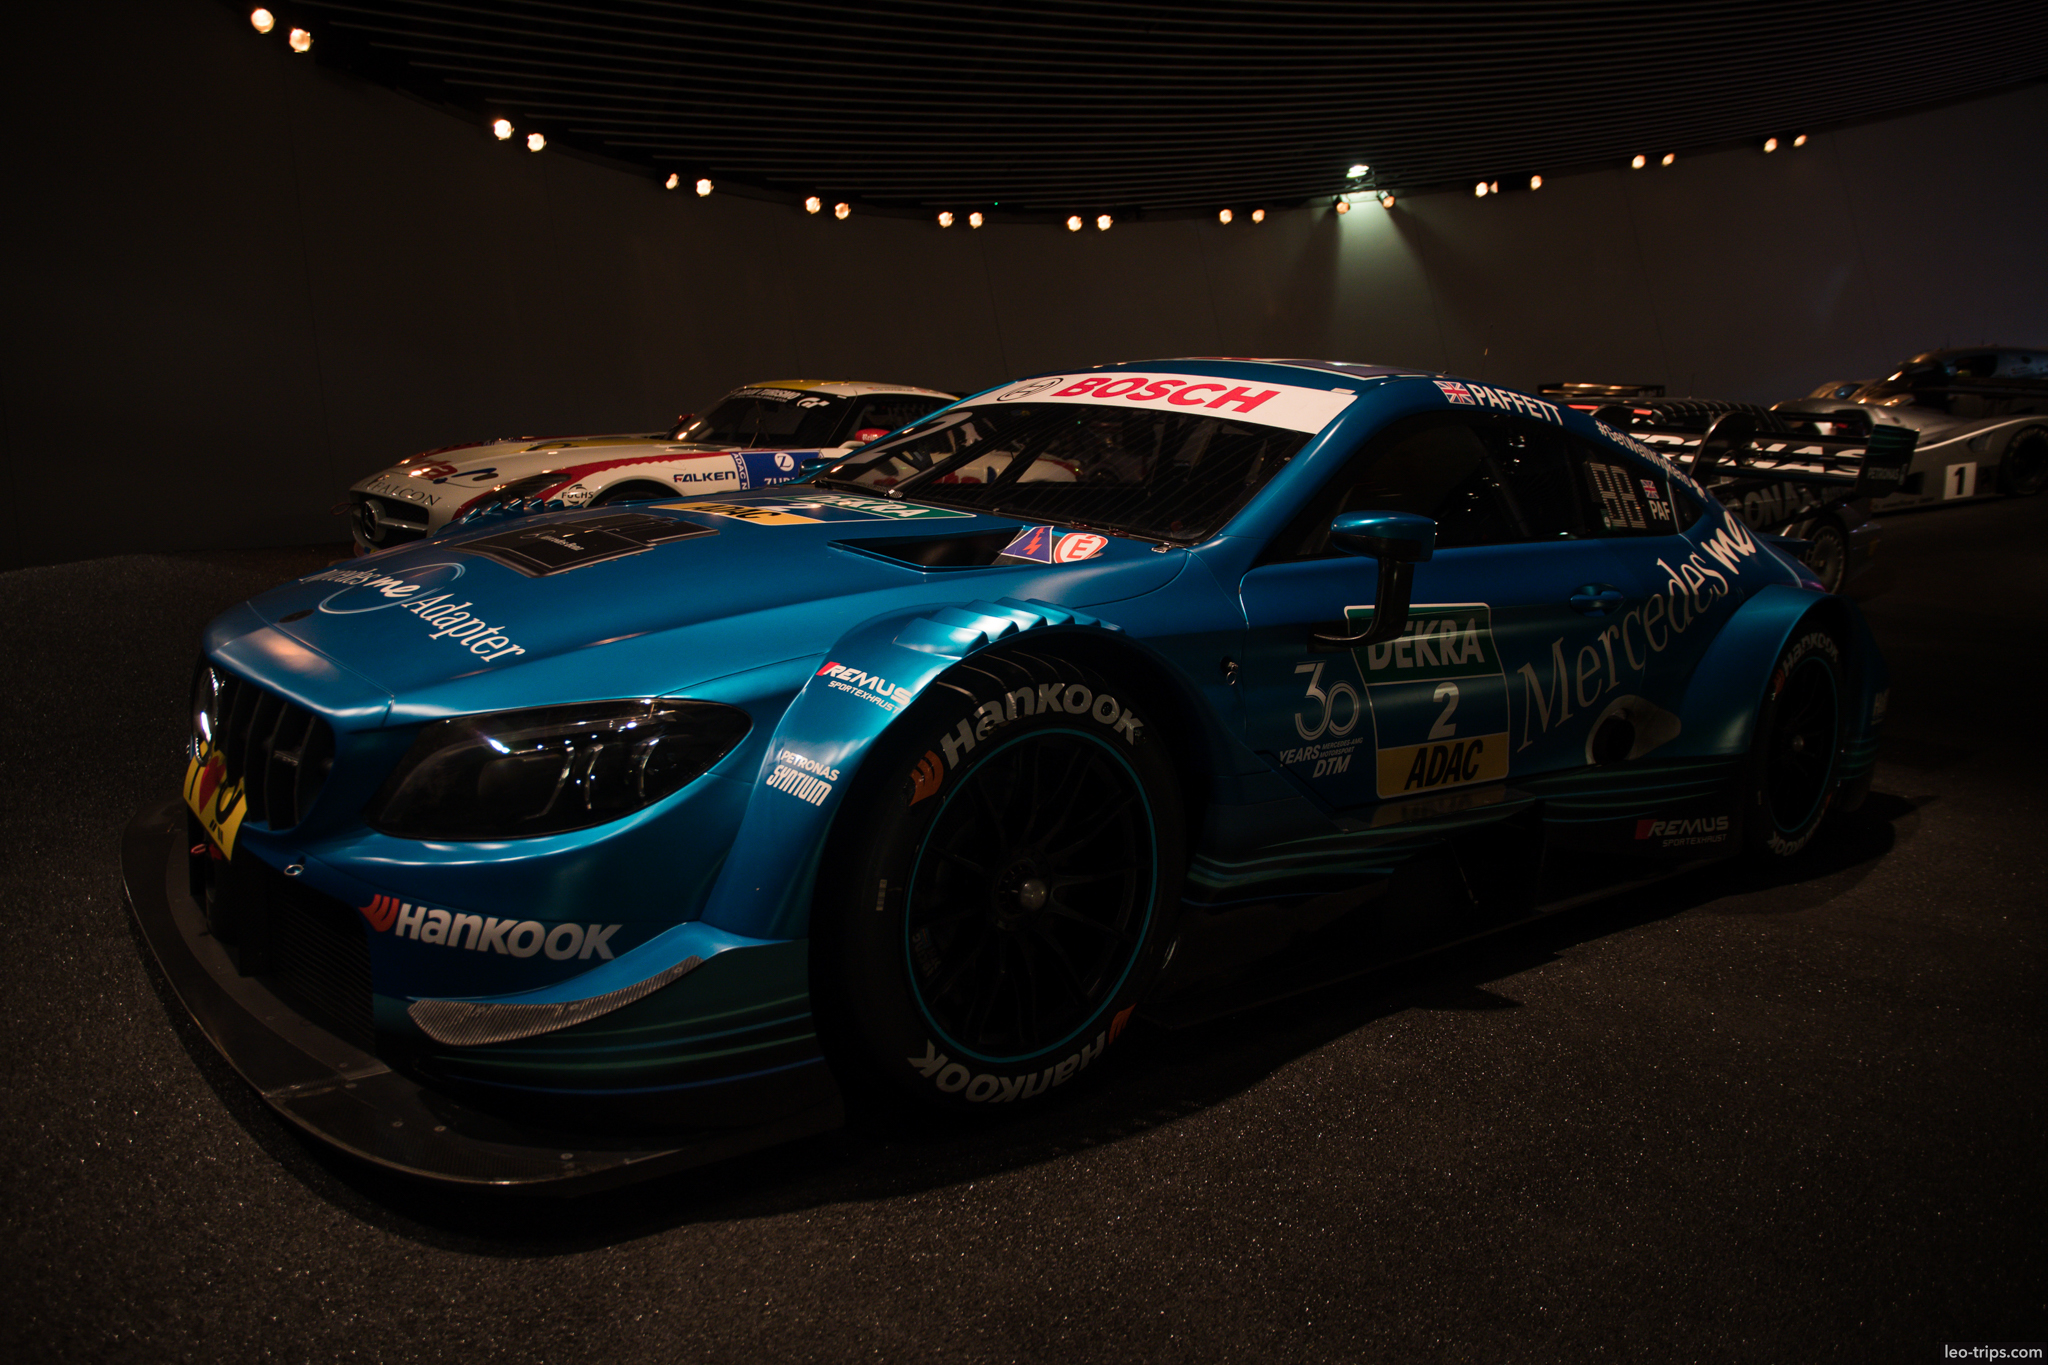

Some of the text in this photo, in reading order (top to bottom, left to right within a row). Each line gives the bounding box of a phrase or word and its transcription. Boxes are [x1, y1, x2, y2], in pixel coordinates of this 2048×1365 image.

[1050, 377, 1282, 413] BOSCH
[1466, 383, 1563, 426] PAFFETT
[673, 471, 736, 483] FALKEN
[1954, 466, 1967, 495] 1
[561, 491, 594, 500] FUCHS
[1648, 500, 1671, 521] PAF
[362, 575, 421, 598] me
[400, 593, 526, 663] Adapter
[1367, 618, 1485, 671] DEKRA
[1517, 511, 1757, 753] Mercedes me
[823, 665, 913, 706] REMUS
[827, 680, 901, 714] SPORTEXHAUST
[1294, 660, 1360, 741] 30
[1427, 681, 1460, 741] 2
[781, 750, 841, 782] PETRONAS
[1280, 744, 1321, 768] YEARS
[1312, 754, 1352, 779] DTM
[1403, 739, 1484, 791] ADAC
[765, 764, 833, 807] SYNTIUM
[1647, 815, 1729, 837] REMUS
[1662, 833, 1728, 848] SPORTEXHAUST
